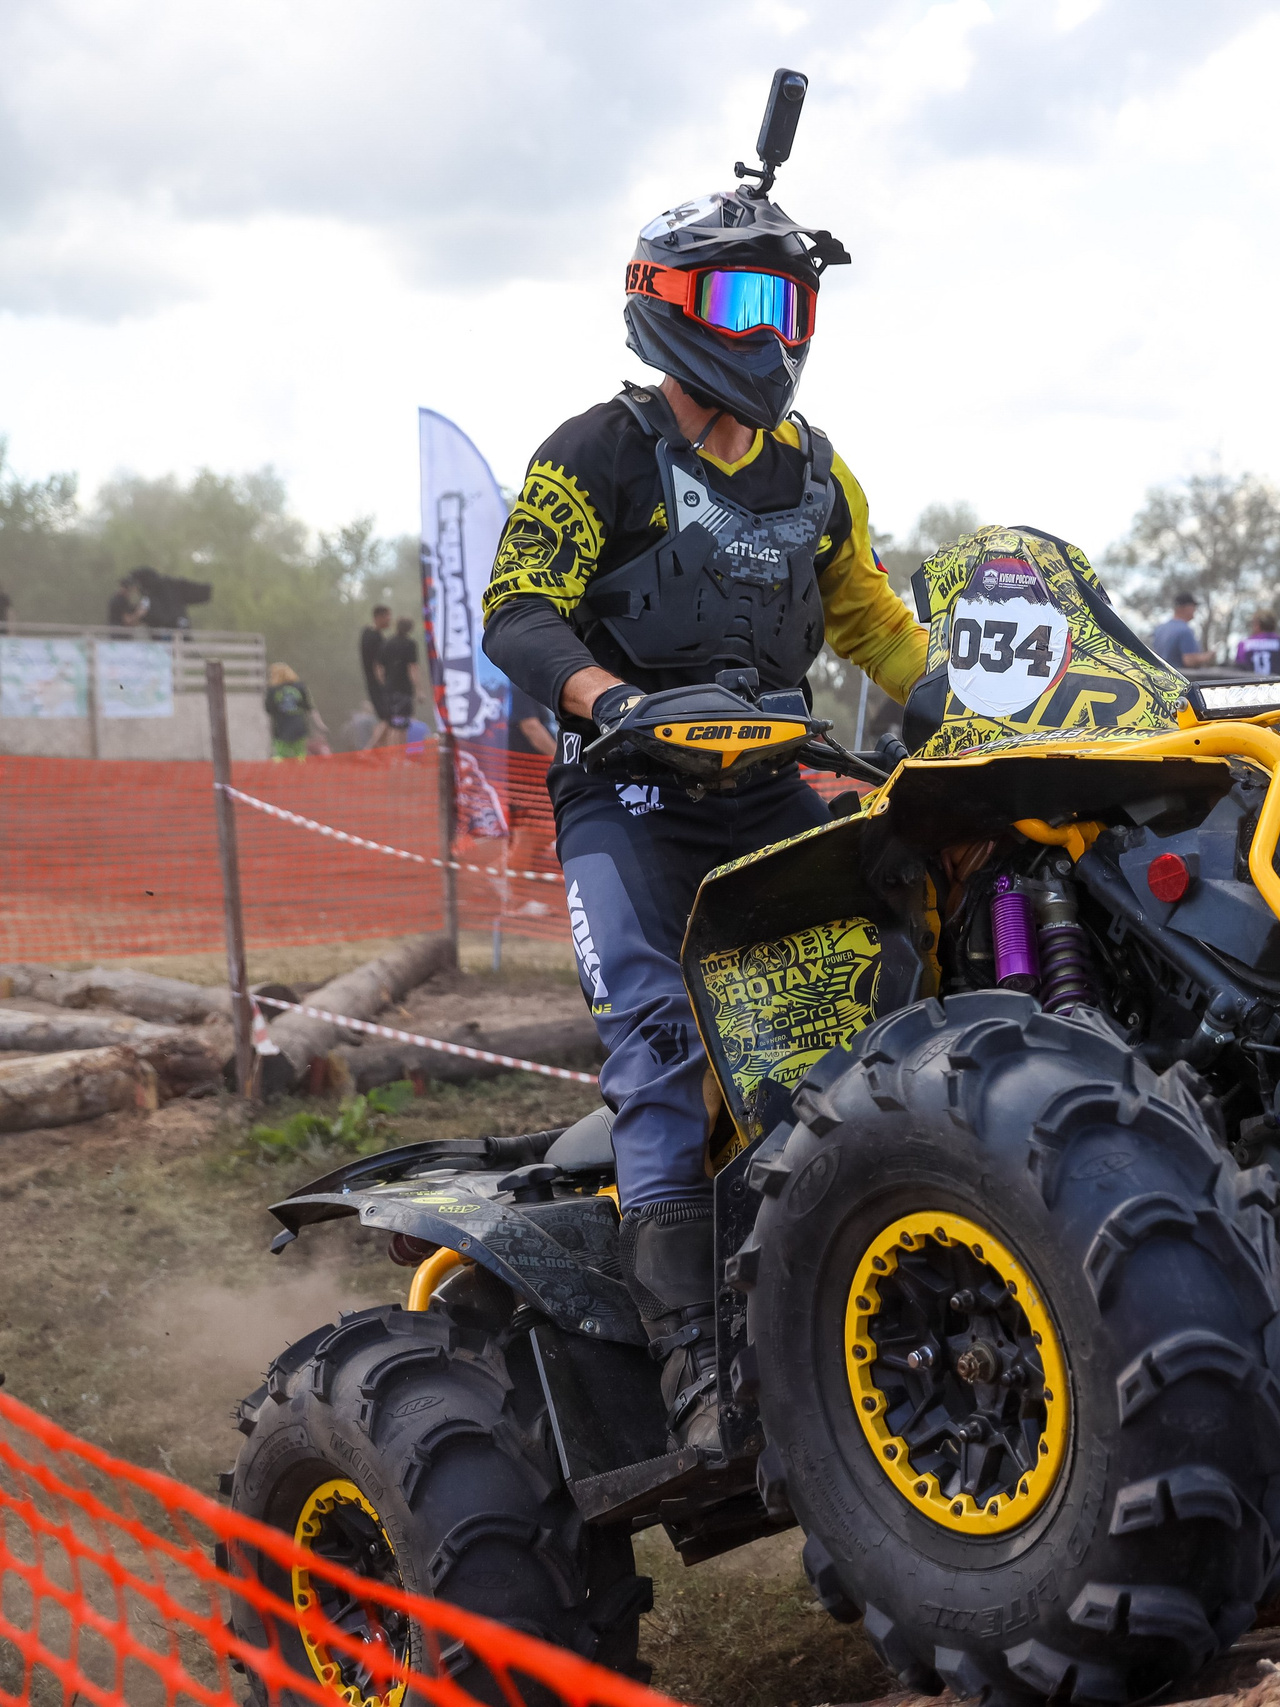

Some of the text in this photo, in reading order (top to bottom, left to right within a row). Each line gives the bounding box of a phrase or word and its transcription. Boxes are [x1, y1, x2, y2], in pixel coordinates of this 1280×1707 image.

[725, 540, 781, 563] ATLAS
[938, 563, 965, 599] BIKE
[951, 618, 1054, 677] 034
[826, 951, 854, 965] POWER
[724, 962, 829, 1006] ROTAX
[754, 1003, 834, 1035] GoPro
